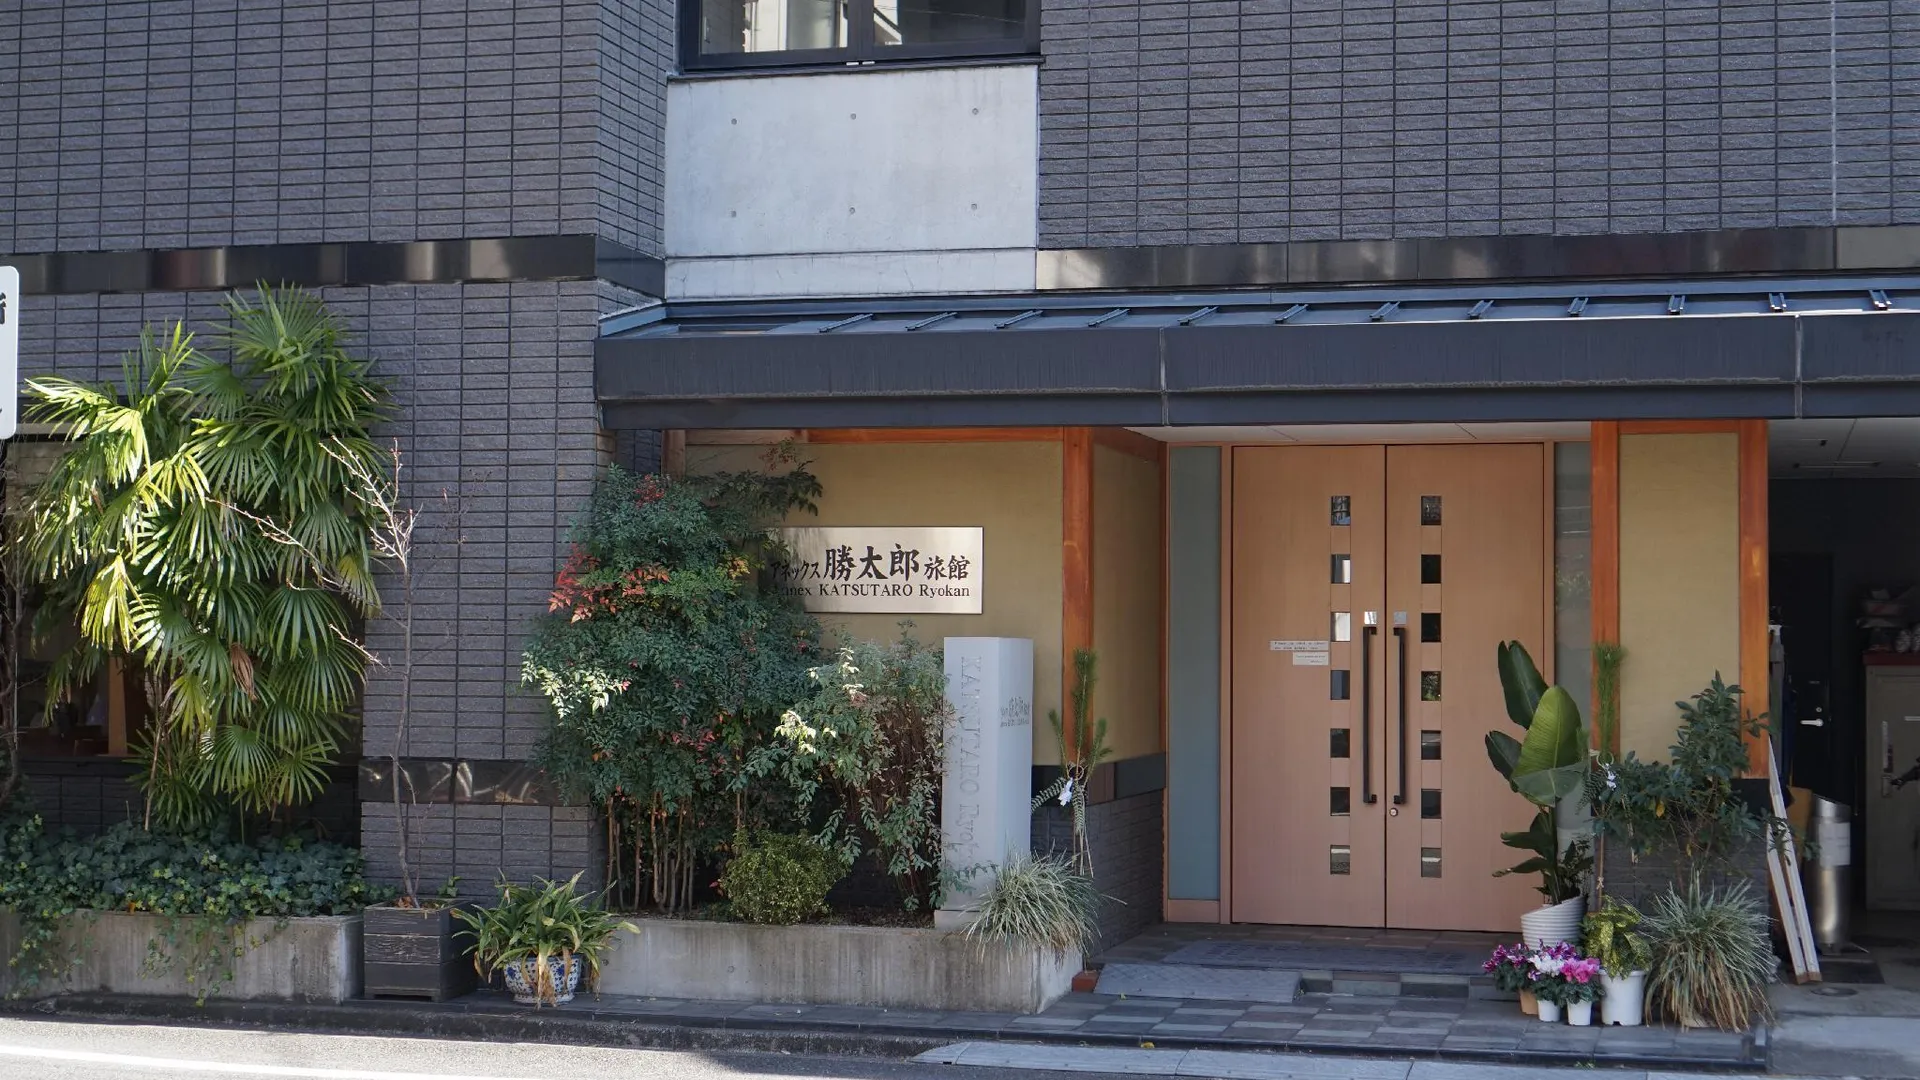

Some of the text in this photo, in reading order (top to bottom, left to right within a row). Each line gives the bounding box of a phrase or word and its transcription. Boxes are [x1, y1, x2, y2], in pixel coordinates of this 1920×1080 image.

[774, 583, 970, 598] nnex KATSUTARO Ryokan
[959, 656, 981, 796] KATSUTARO
